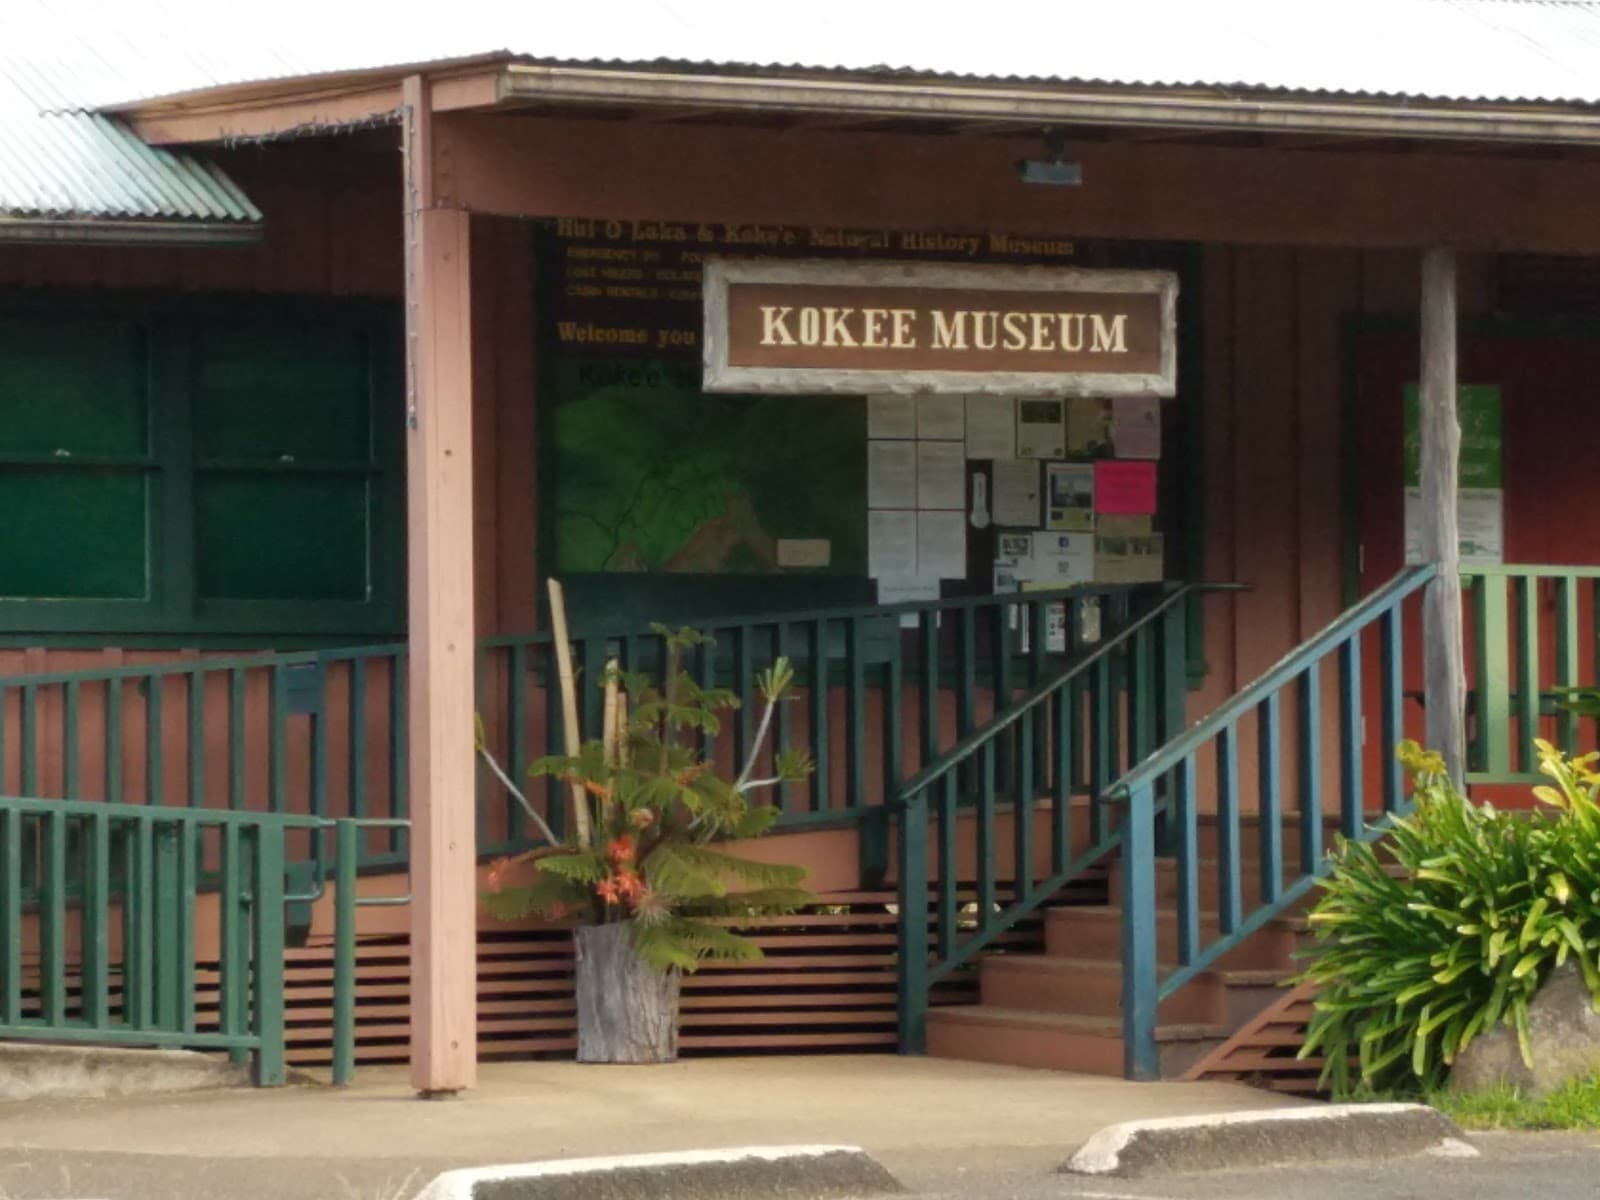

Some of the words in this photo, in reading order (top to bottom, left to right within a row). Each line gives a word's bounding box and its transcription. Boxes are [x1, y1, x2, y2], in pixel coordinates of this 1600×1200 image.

[901, 232, 980, 256] History
[988, 235, 1075, 256] Museum
[555, 321, 649, 344] Welcome
[656, 329, 696, 348] you
[759, 305, 917, 350] KOKEE
[931, 309, 1128, 352] MUSEUM
